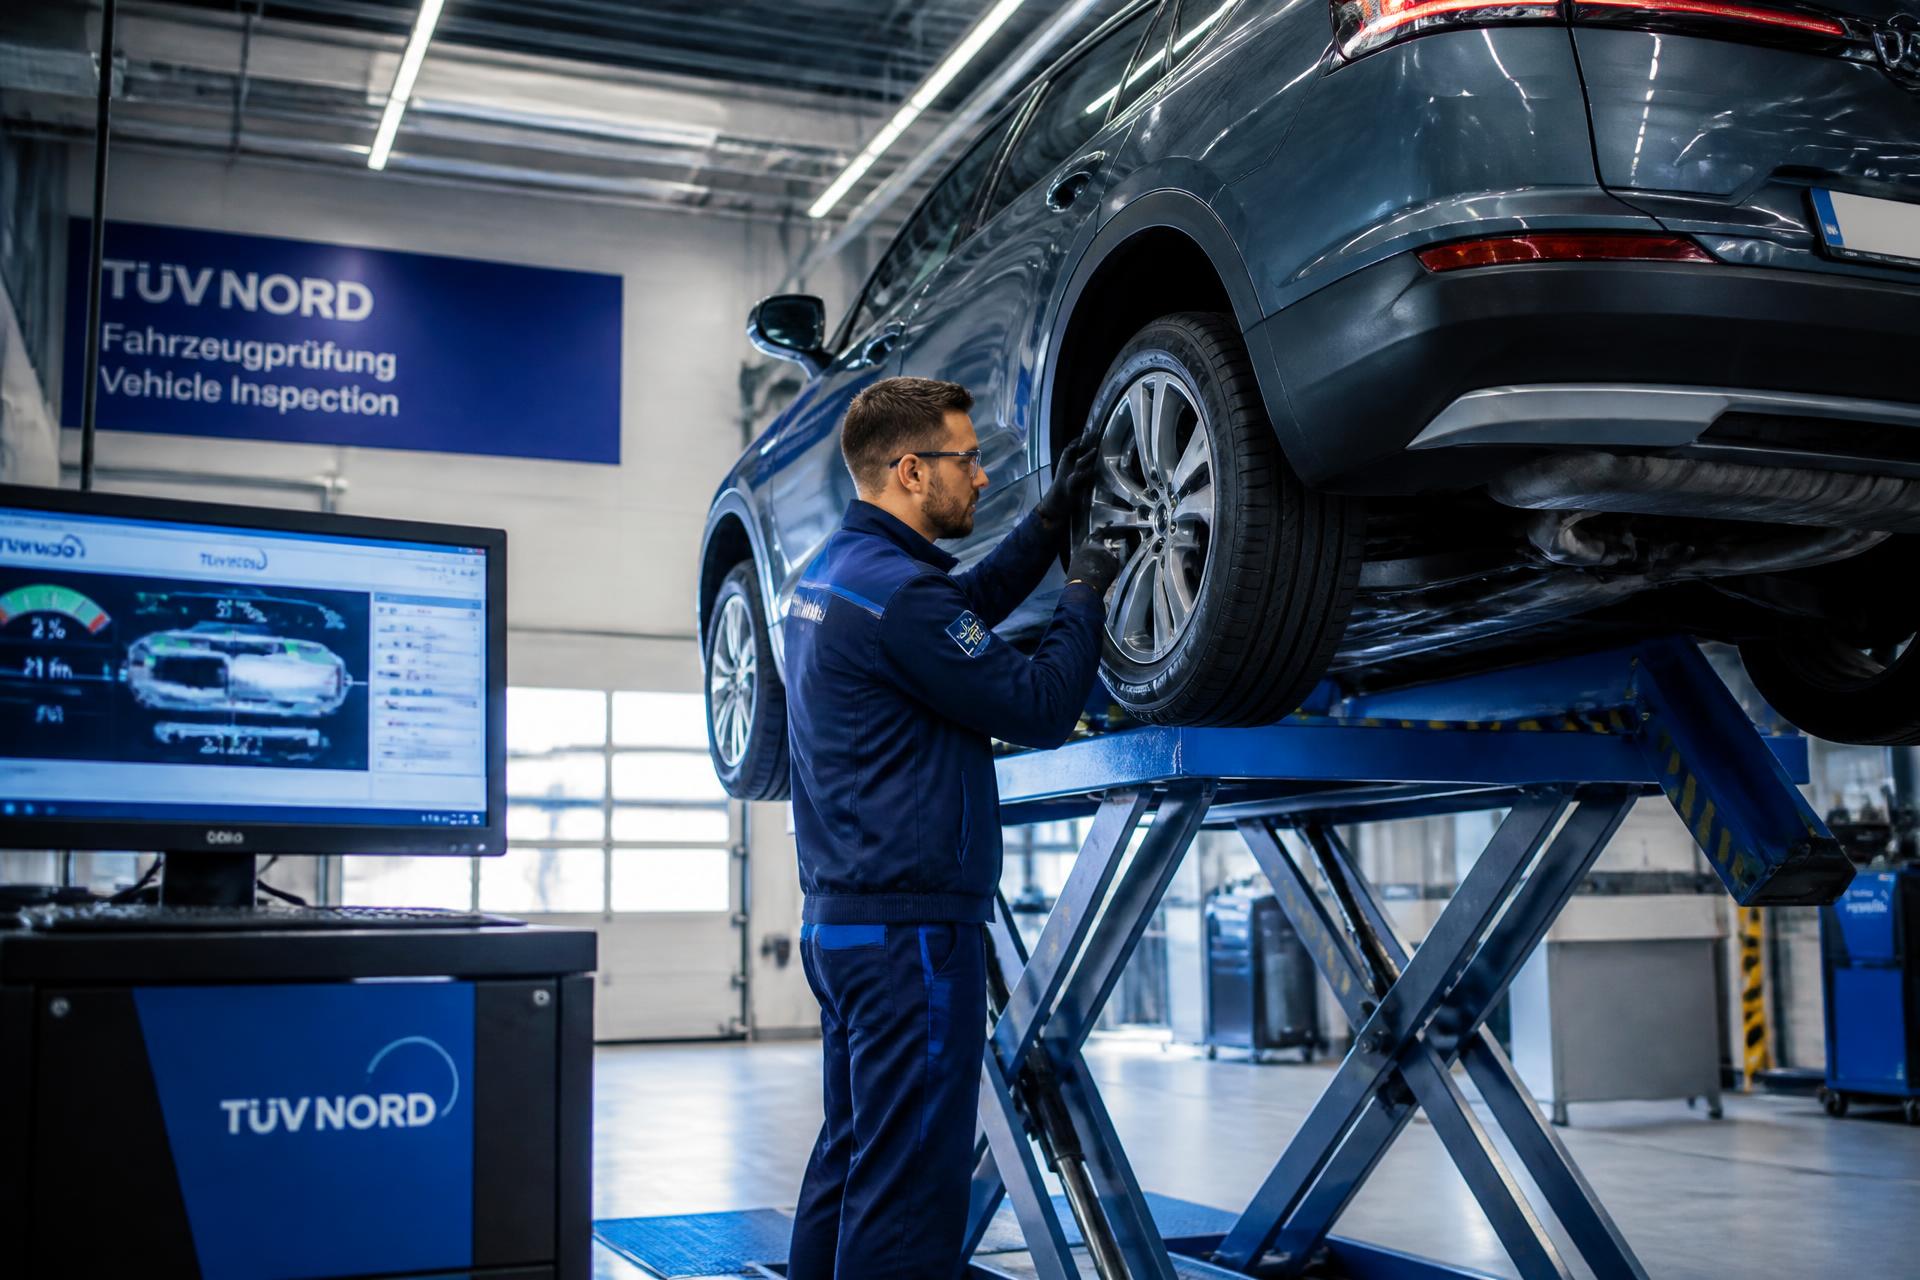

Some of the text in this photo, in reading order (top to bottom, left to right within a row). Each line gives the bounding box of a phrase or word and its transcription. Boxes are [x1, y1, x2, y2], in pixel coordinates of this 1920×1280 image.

[101, 260, 374, 321] TÜV NORD
[102, 323, 397, 382] Fahrzeugprüfung
[101, 367, 398, 417] Vehicle Inspection
[220, 1093, 437, 1134] TÜV NORD
